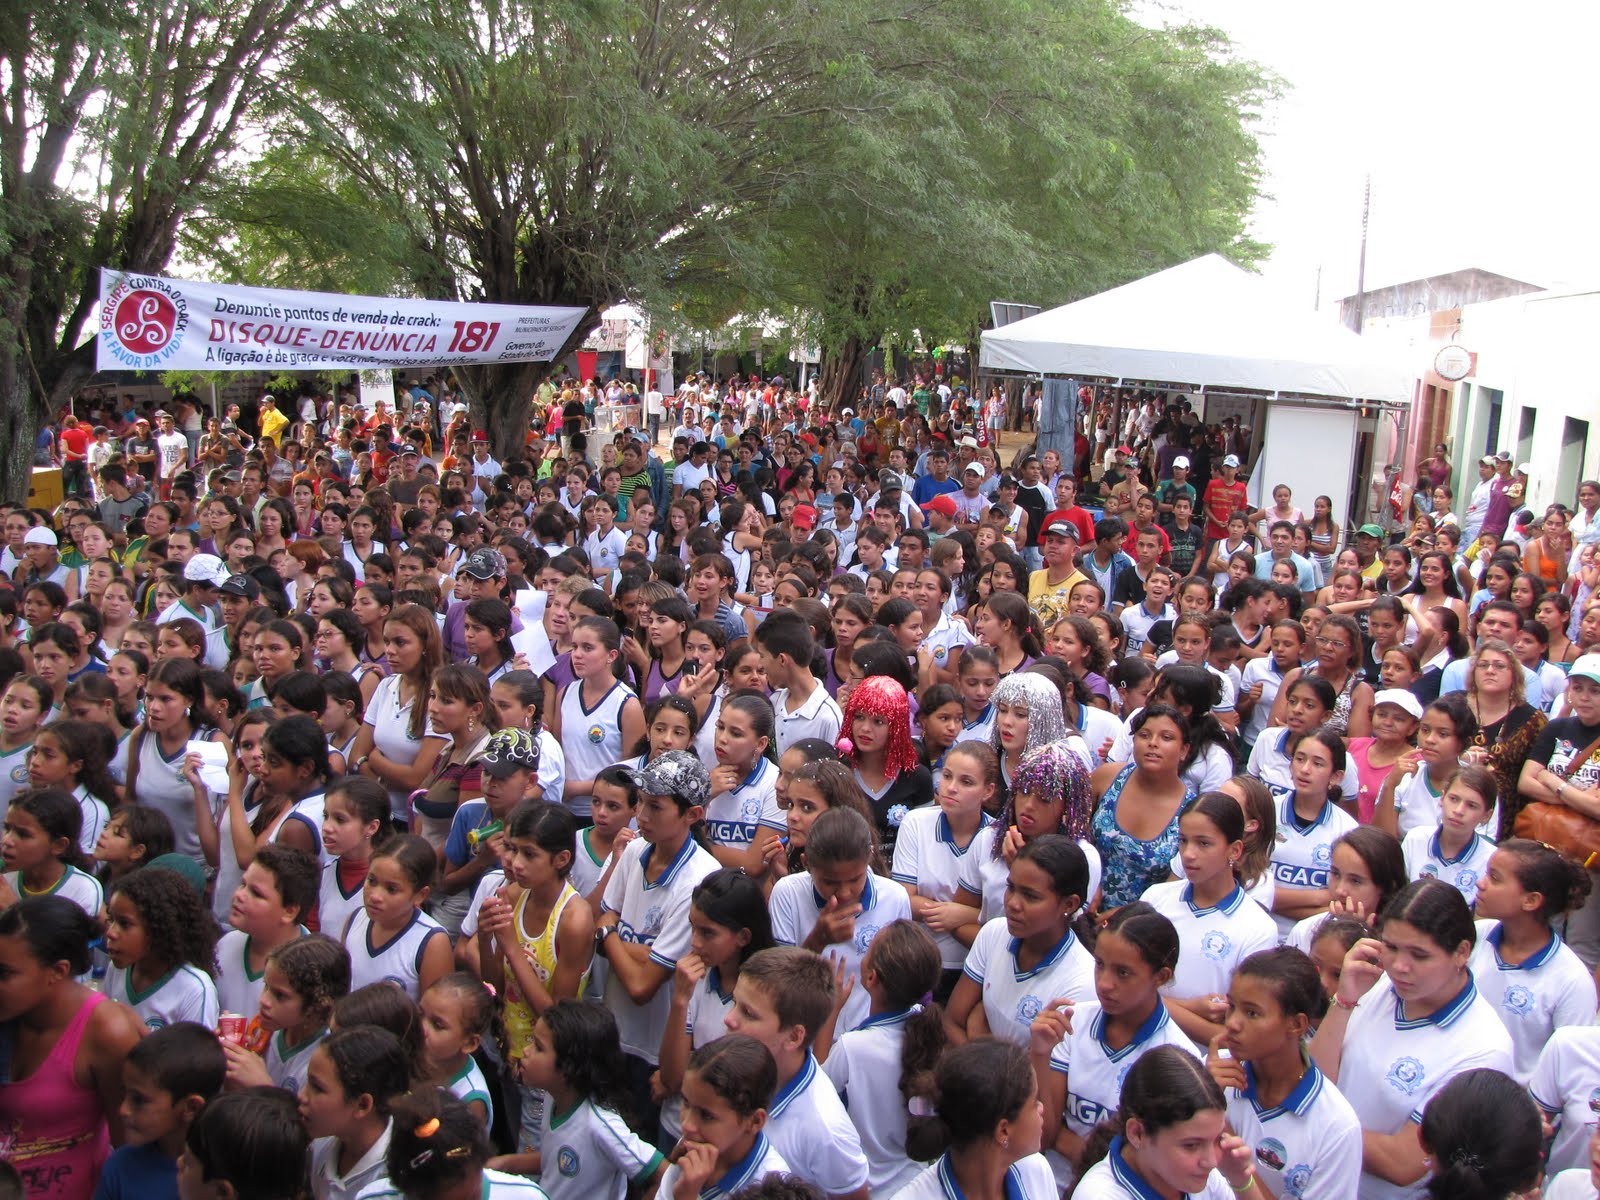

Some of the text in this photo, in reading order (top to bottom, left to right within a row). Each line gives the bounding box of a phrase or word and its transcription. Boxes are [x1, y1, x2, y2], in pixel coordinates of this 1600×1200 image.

[101, 278, 190, 332] SERGIPE CONTRA O CRACK
[214, 297, 441, 327] Denuncie pontos de venda de crack:
[103, 331, 184, 368] A FAVOR DA VIDA
[208, 319, 438, 353] DISQUE-DENÚNCIA
[447, 321, 501, 353] 181
[205, 347, 215, 362] A
[217, 347, 264, 365] ligação
[266, 350, 273, 362] é
[275, 349, 289, 362] de
[290, 352, 319, 365] graça
